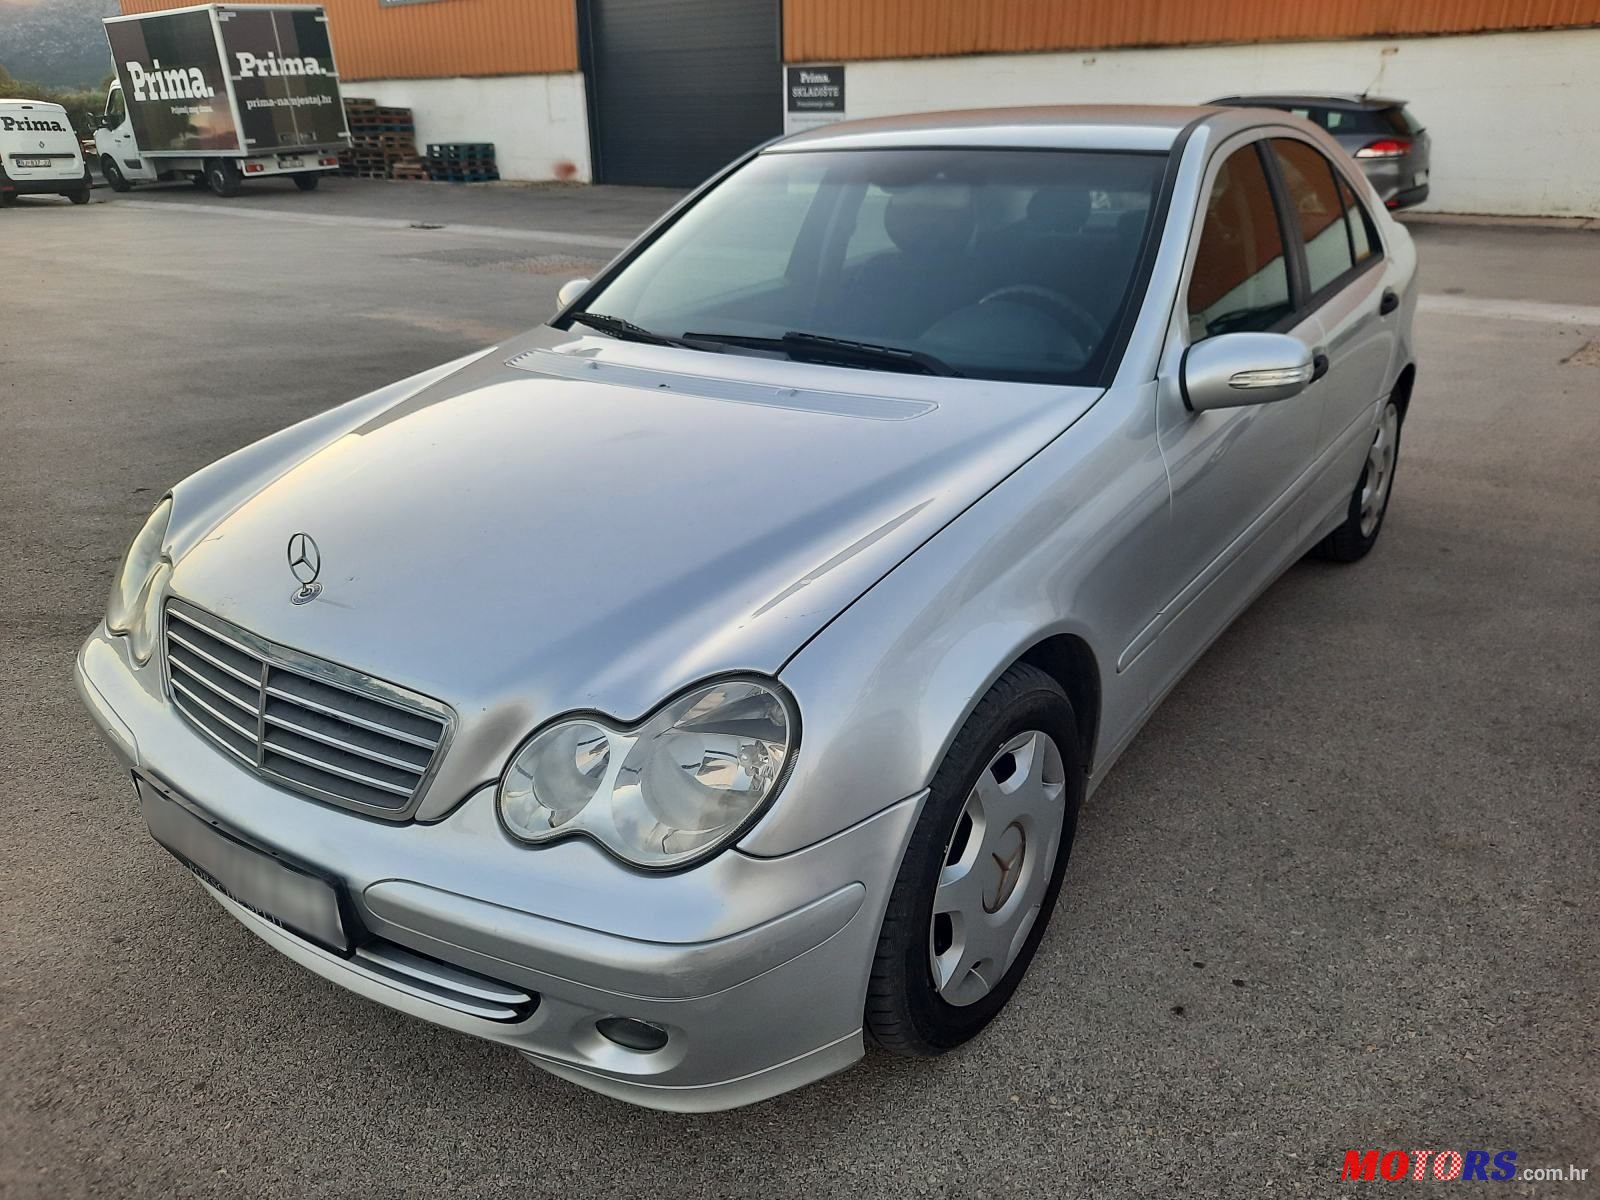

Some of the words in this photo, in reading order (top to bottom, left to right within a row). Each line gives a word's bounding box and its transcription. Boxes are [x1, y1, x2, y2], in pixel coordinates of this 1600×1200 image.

[235, 51, 327, 77] Prima.
[126, 59, 215, 102] Prima.
[0, 116, 67, 132] Prima.
